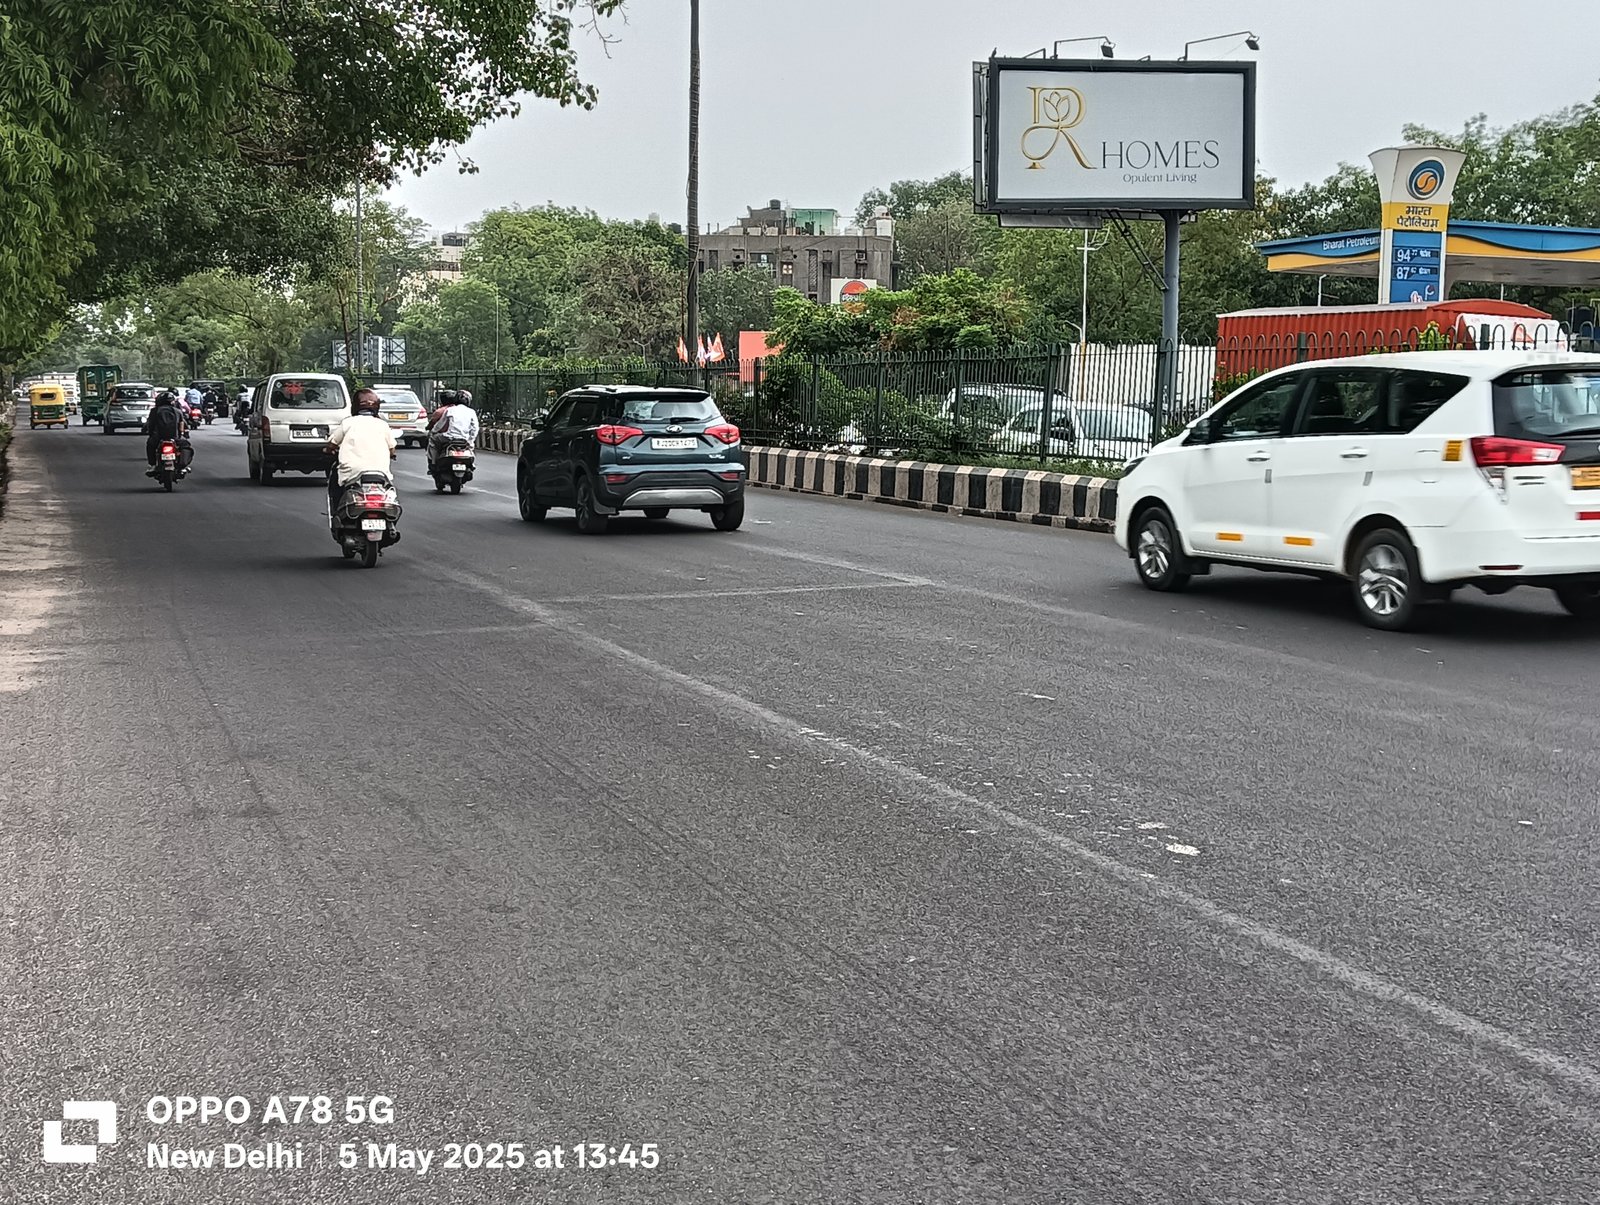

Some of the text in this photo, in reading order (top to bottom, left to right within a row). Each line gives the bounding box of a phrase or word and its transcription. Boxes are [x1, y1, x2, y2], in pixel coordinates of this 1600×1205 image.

[1101, 140, 1220, 169] HOMES
[1122, 172, 1198, 184] Opulent Living
[1405, 205, 1432, 216] भारत
[1322, 239, 1345, 251] Bharat
[1397, 249, 1411, 262] 94
[1396, 266, 1410, 280] 87
